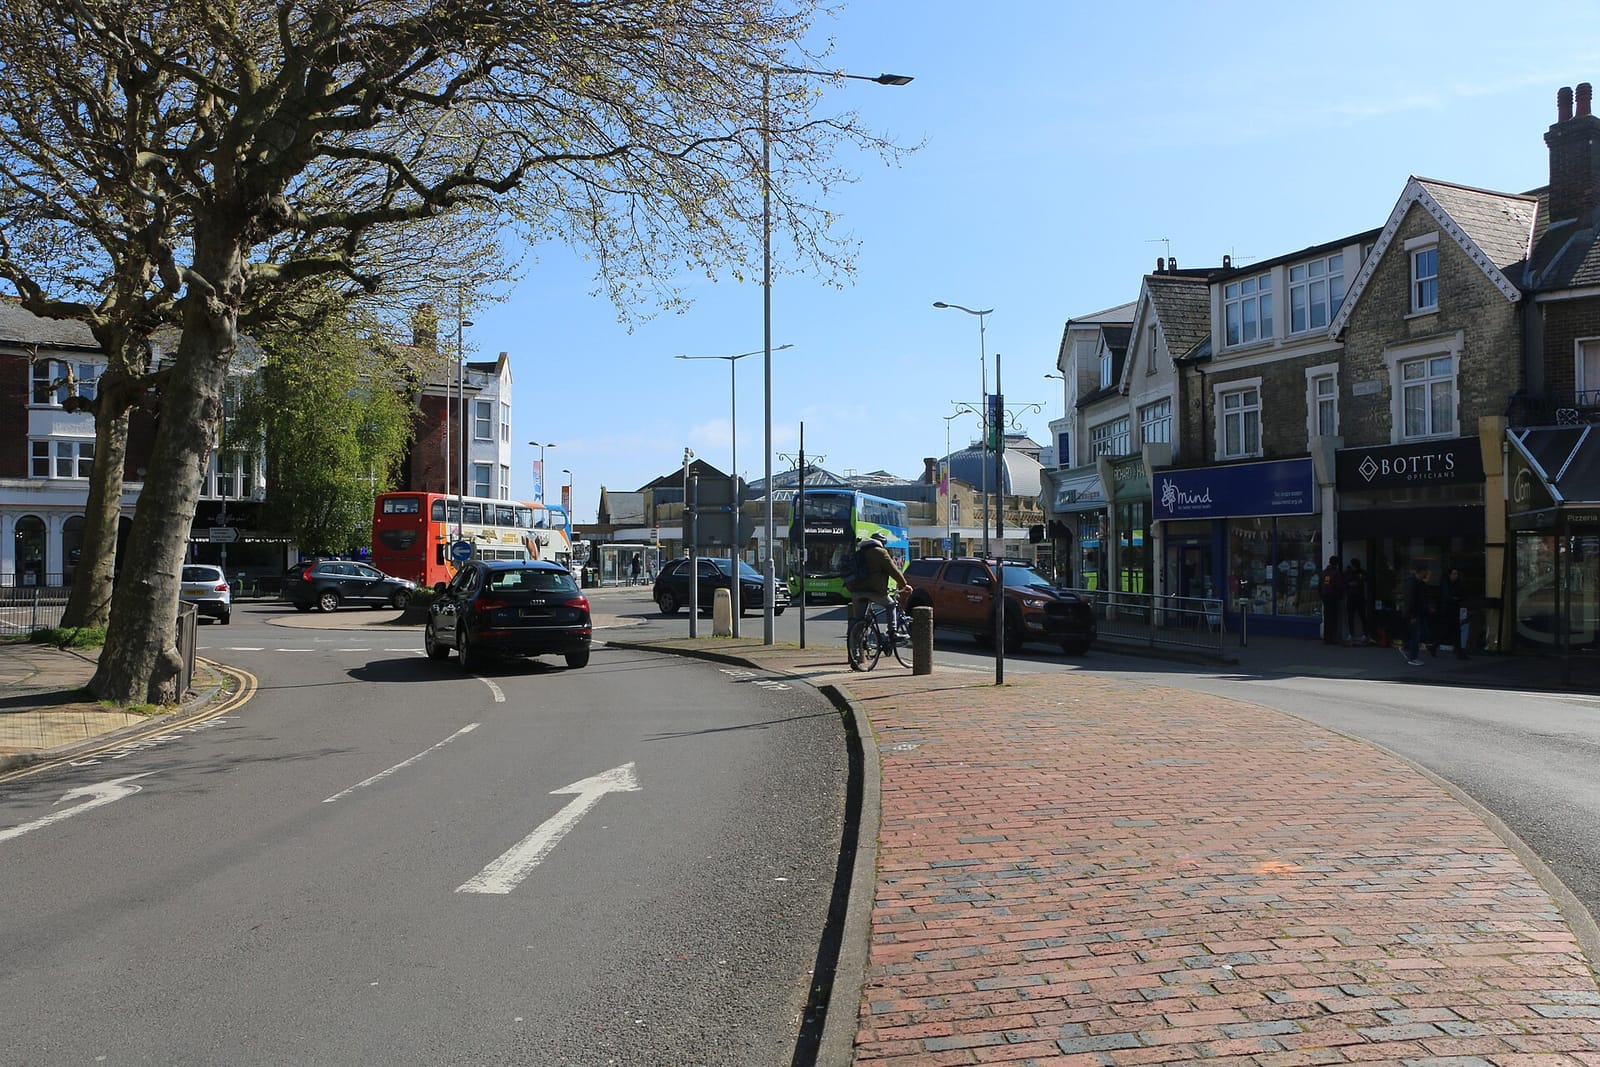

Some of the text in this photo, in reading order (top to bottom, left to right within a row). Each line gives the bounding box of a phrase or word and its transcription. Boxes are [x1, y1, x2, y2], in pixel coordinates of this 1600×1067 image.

[1381, 452, 1455, 475] BOTT'S
[1407, 471, 1455, 481] OPTICIANS
[1177, 487, 1212, 504] mind
